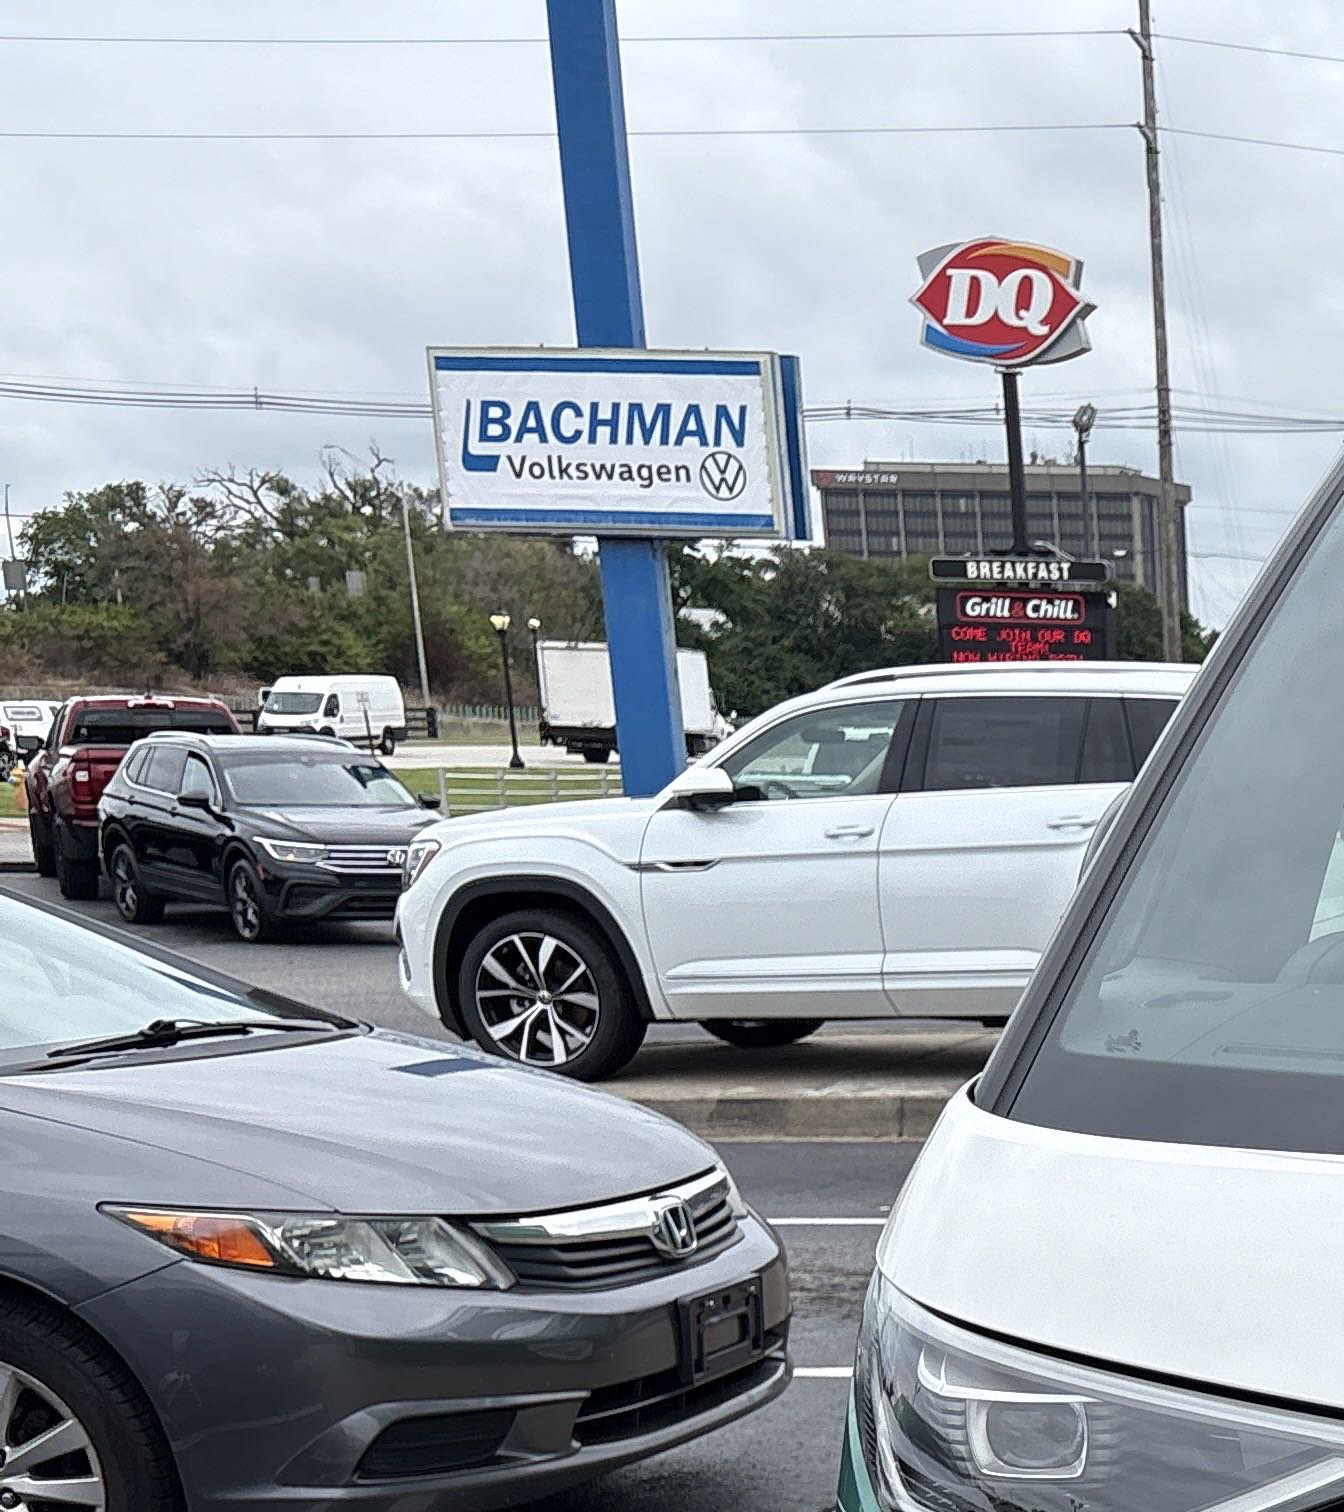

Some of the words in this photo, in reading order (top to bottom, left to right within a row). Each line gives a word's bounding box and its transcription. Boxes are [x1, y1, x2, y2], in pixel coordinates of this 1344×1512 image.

[943, 268, 1054, 336] DQ
[478, 400, 747, 448] BACHMAN
[506, 455, 691, 488] Volkswagen
[966, 561, 1071, 581] BREAKFAST
[951, 627, 988, 641] COME
[997, 628, 1032, 642] JOIN
[1038, 629, 1065, 643] OUR
